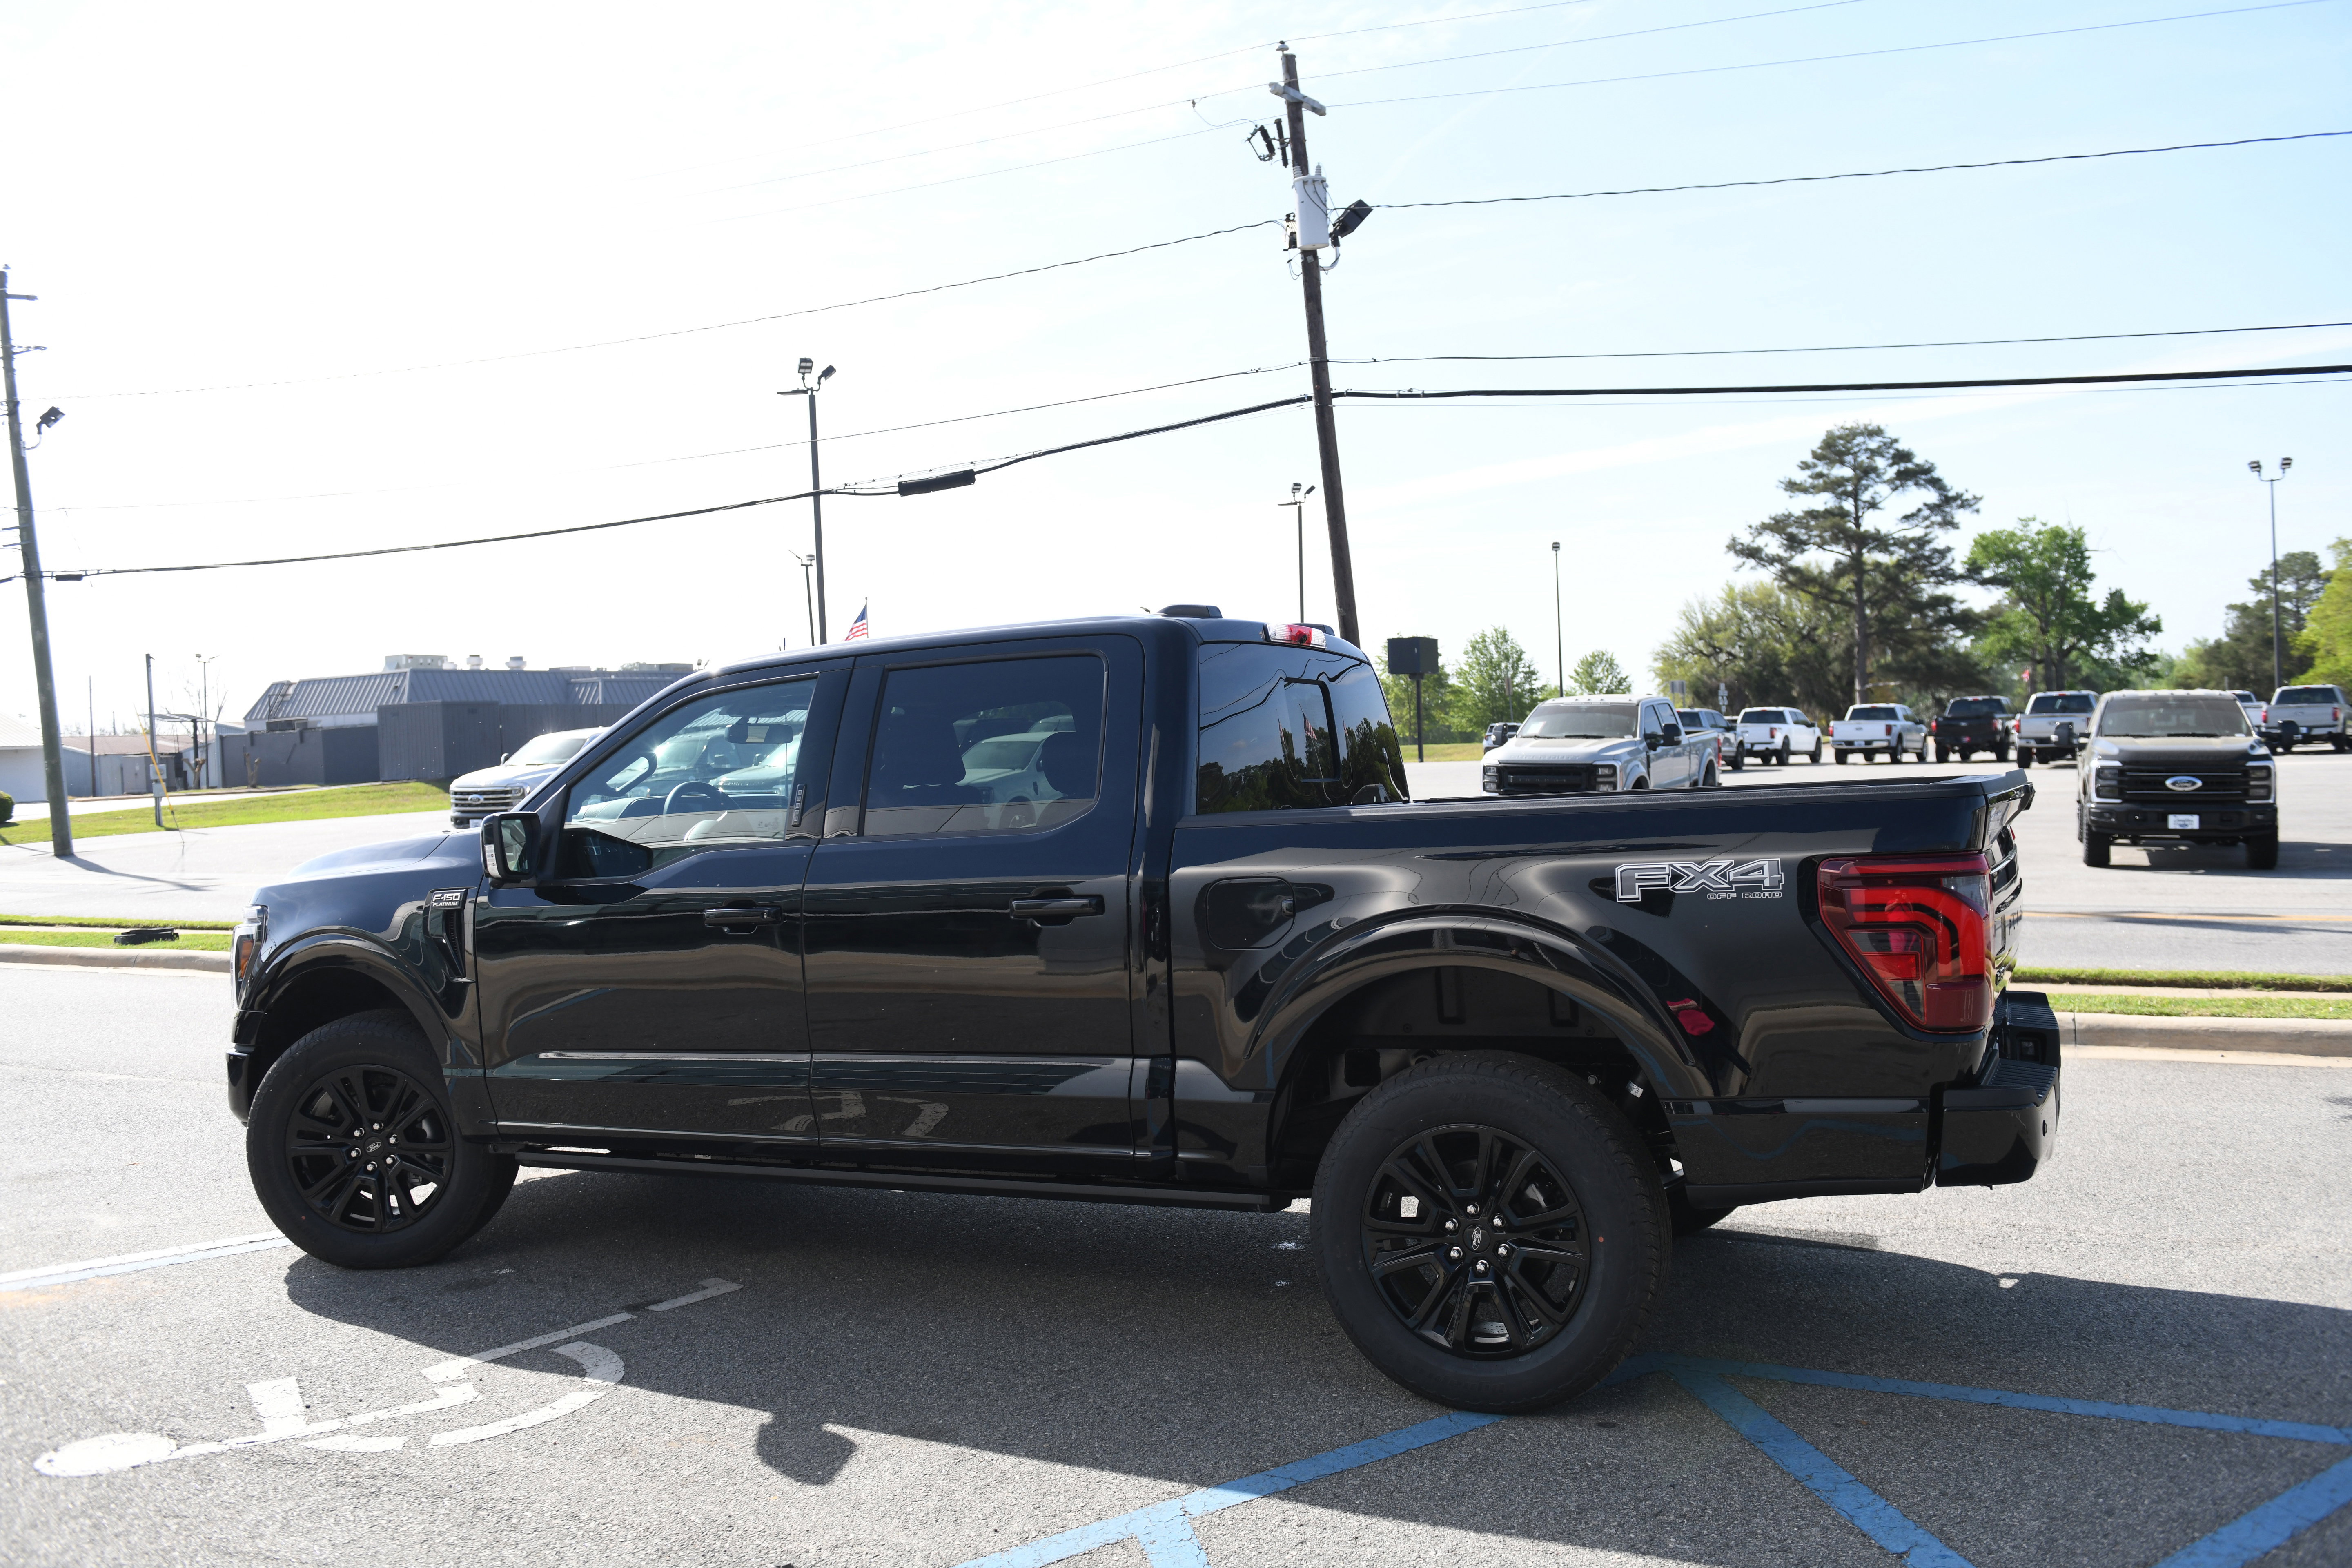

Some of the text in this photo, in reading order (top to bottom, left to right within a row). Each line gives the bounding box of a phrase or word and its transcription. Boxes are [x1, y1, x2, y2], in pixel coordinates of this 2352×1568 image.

[1616, 858, 1784, 902] FX4
[433, 893, 461, 902] F-150
[369, 1143, 379, 1151] Ford
